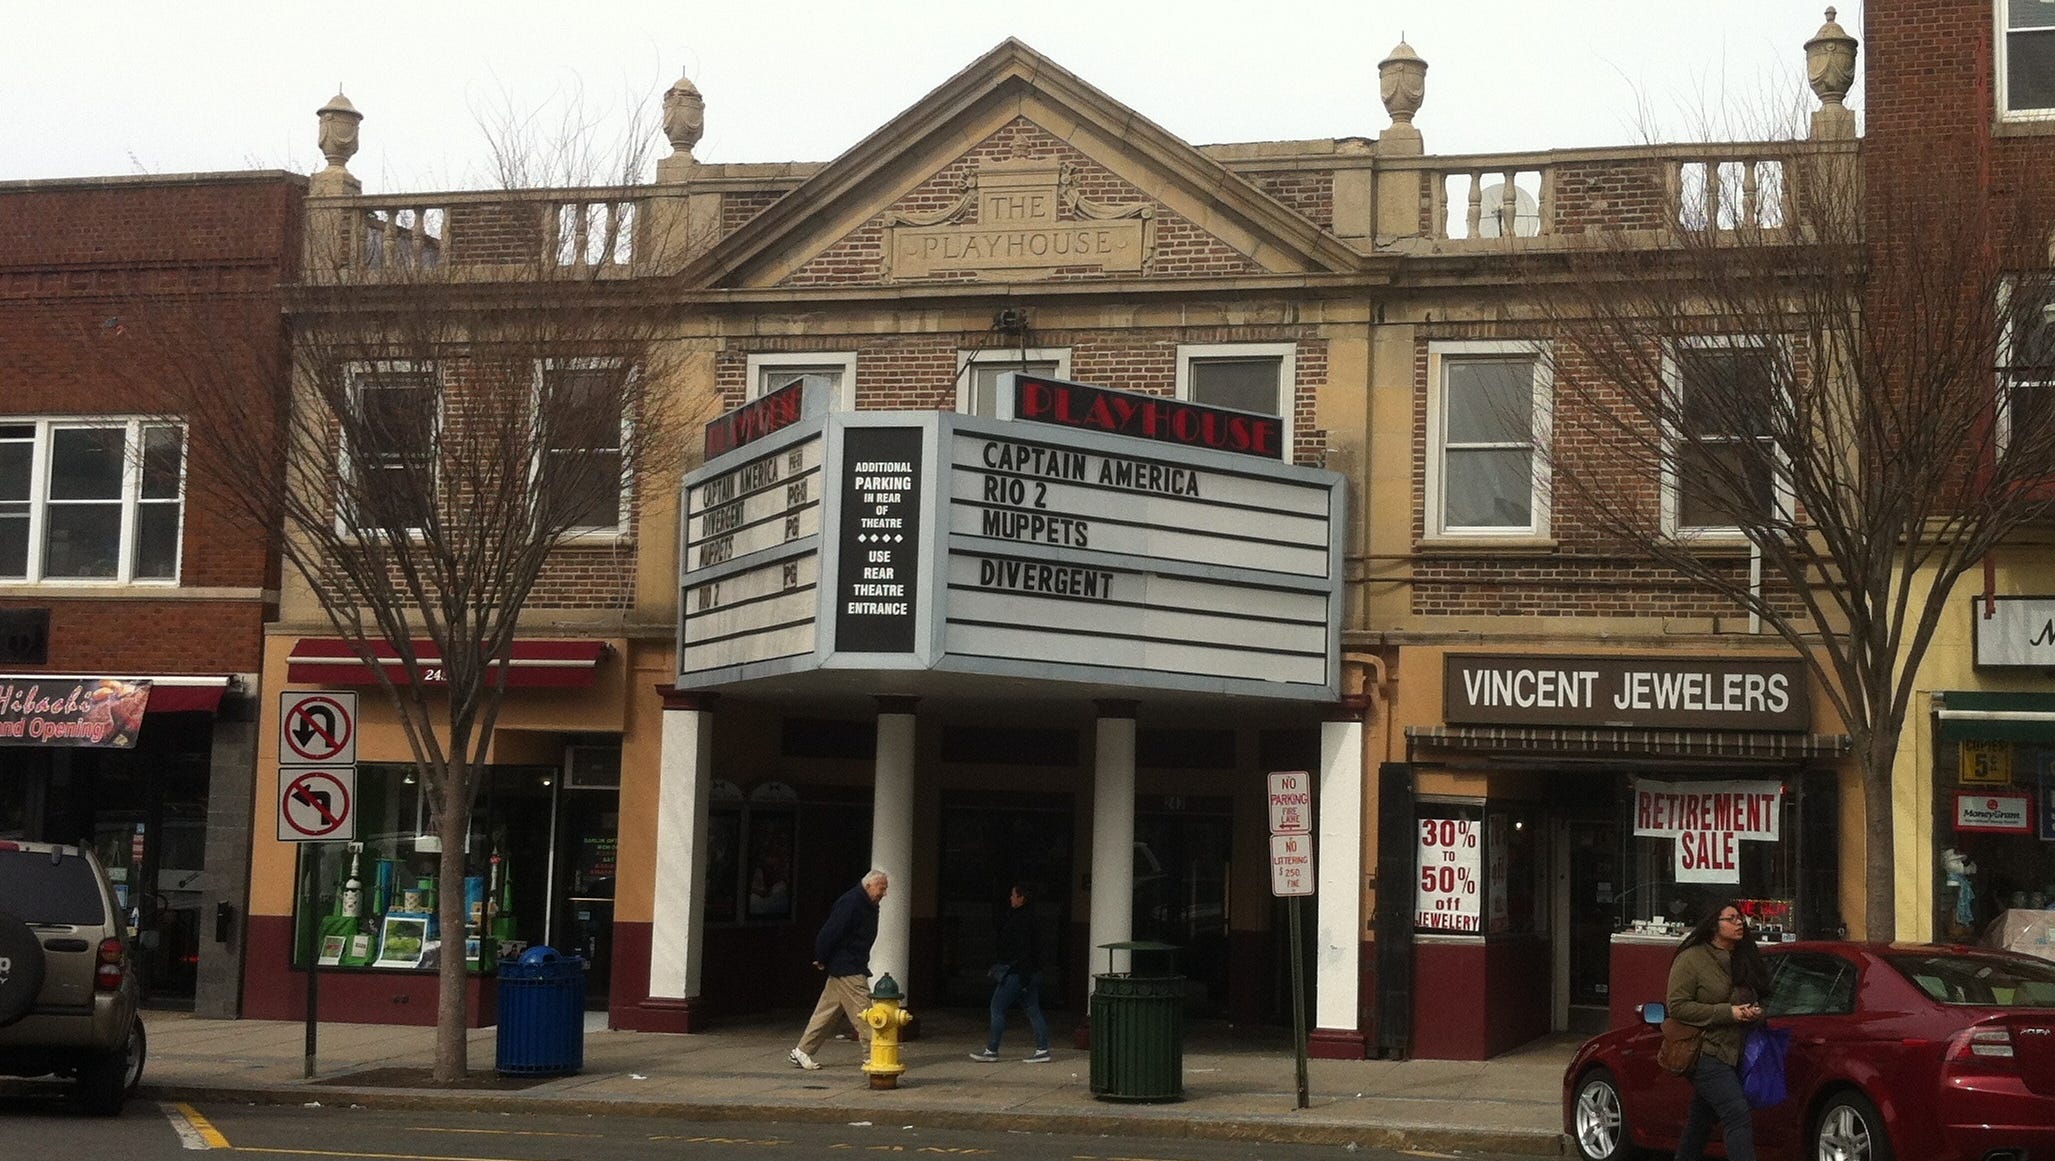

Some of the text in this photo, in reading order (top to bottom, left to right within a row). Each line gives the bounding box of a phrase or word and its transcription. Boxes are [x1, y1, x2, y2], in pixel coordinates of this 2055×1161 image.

[989, 195, 1046, 220] THE
[922, 231, 1113, 260] PLAYHOUSE
[1022, 382, 1276, 454] PLAYHOUSE
[855, 462, 913, 473] ADDITIONAL
[983, 441, 1200, 497] CAPTAIN AMERICA
[740, 457, 778, 495] AMERICA
[855, 477, 912, 491] PARKING
[864, 493, 901, 503] IN REAR
[984, 475, 1047, 508] RIO 2
[875, 505, 889, 516] OF
[702, 501, 744, 537] DIVERGENT
[861, 518, 903, 528] THEATRE
[983, 509, 1089, 547] MUPPETS
[868, 551, 891, 563] USE
[863, 567, 894, 580] REAR
[980, 558, 1114, 599] DIVERGENT
[853, 584, 904, 597] THEATRE
[847, 602, 908, 616] ENTRANCE
[1463, 669, 1790, 714] VINCENT JEWELERS
[29, 717, 105, 743] Opening
[1281, 777, 1297, 790] NO
[1271, 793, 1309, 806] PARKING
[1282, 807, 1297, 815] FIRE
[1638, 791, 1775, 833] RETIREMENT
[1963, 809, 2021, 820] MoneyGram
[1281, 815, 1300, 824] LANE
[1421, 818, 1476, 848] 30%
[1285, 840, 1297, 853] NO
[1681, 831, 1735, 870] SALE
[1273, 856, 1309, 866] LITTERING
[1442, 850, 1456, 862] TO
[1287, 880, 1301, 888] FINE
[1421, 865, 1476, 895] 50%
[1435, 897, 1461, 911] off
[1415, 911, 1479, 932] JEWELERY
